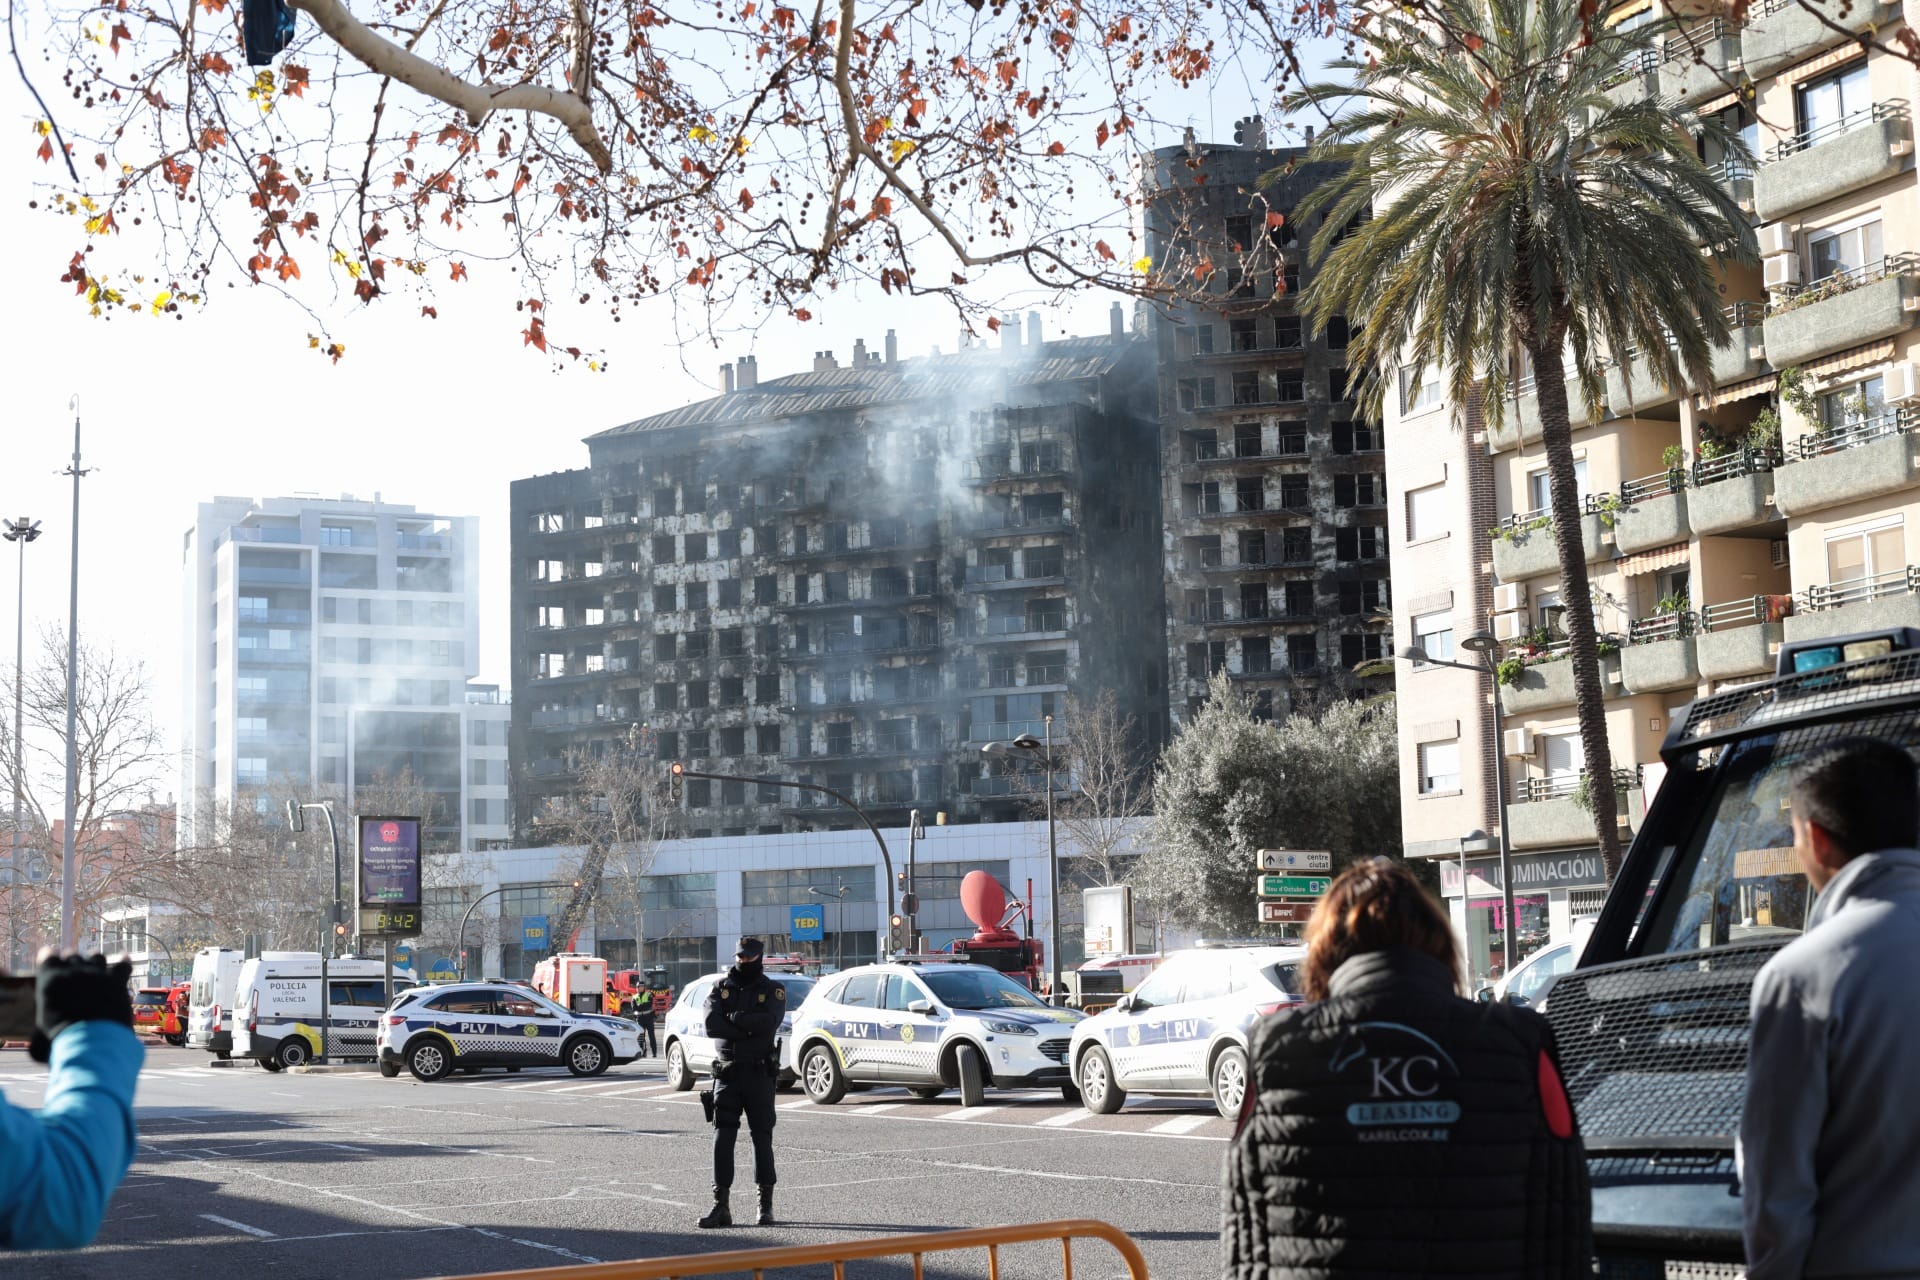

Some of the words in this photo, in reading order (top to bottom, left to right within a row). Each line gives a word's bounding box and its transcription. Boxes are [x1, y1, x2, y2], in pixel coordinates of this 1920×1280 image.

[377, 914, 414, 928] 9:42
[793, 918, 818, 929] TEDi
[525, 928, 544, 938] TEDi
[348, 1020, 370, 1028] PLV
[460, 1022, 487, 1034] PLV
[844, 1022, 869, 1038] PLV
[1175, 1020, 1199, 1039] PLV
[1369, 1055, 1439, 1097] KC
[1358, 1104, 1449, 1121] LEASING
